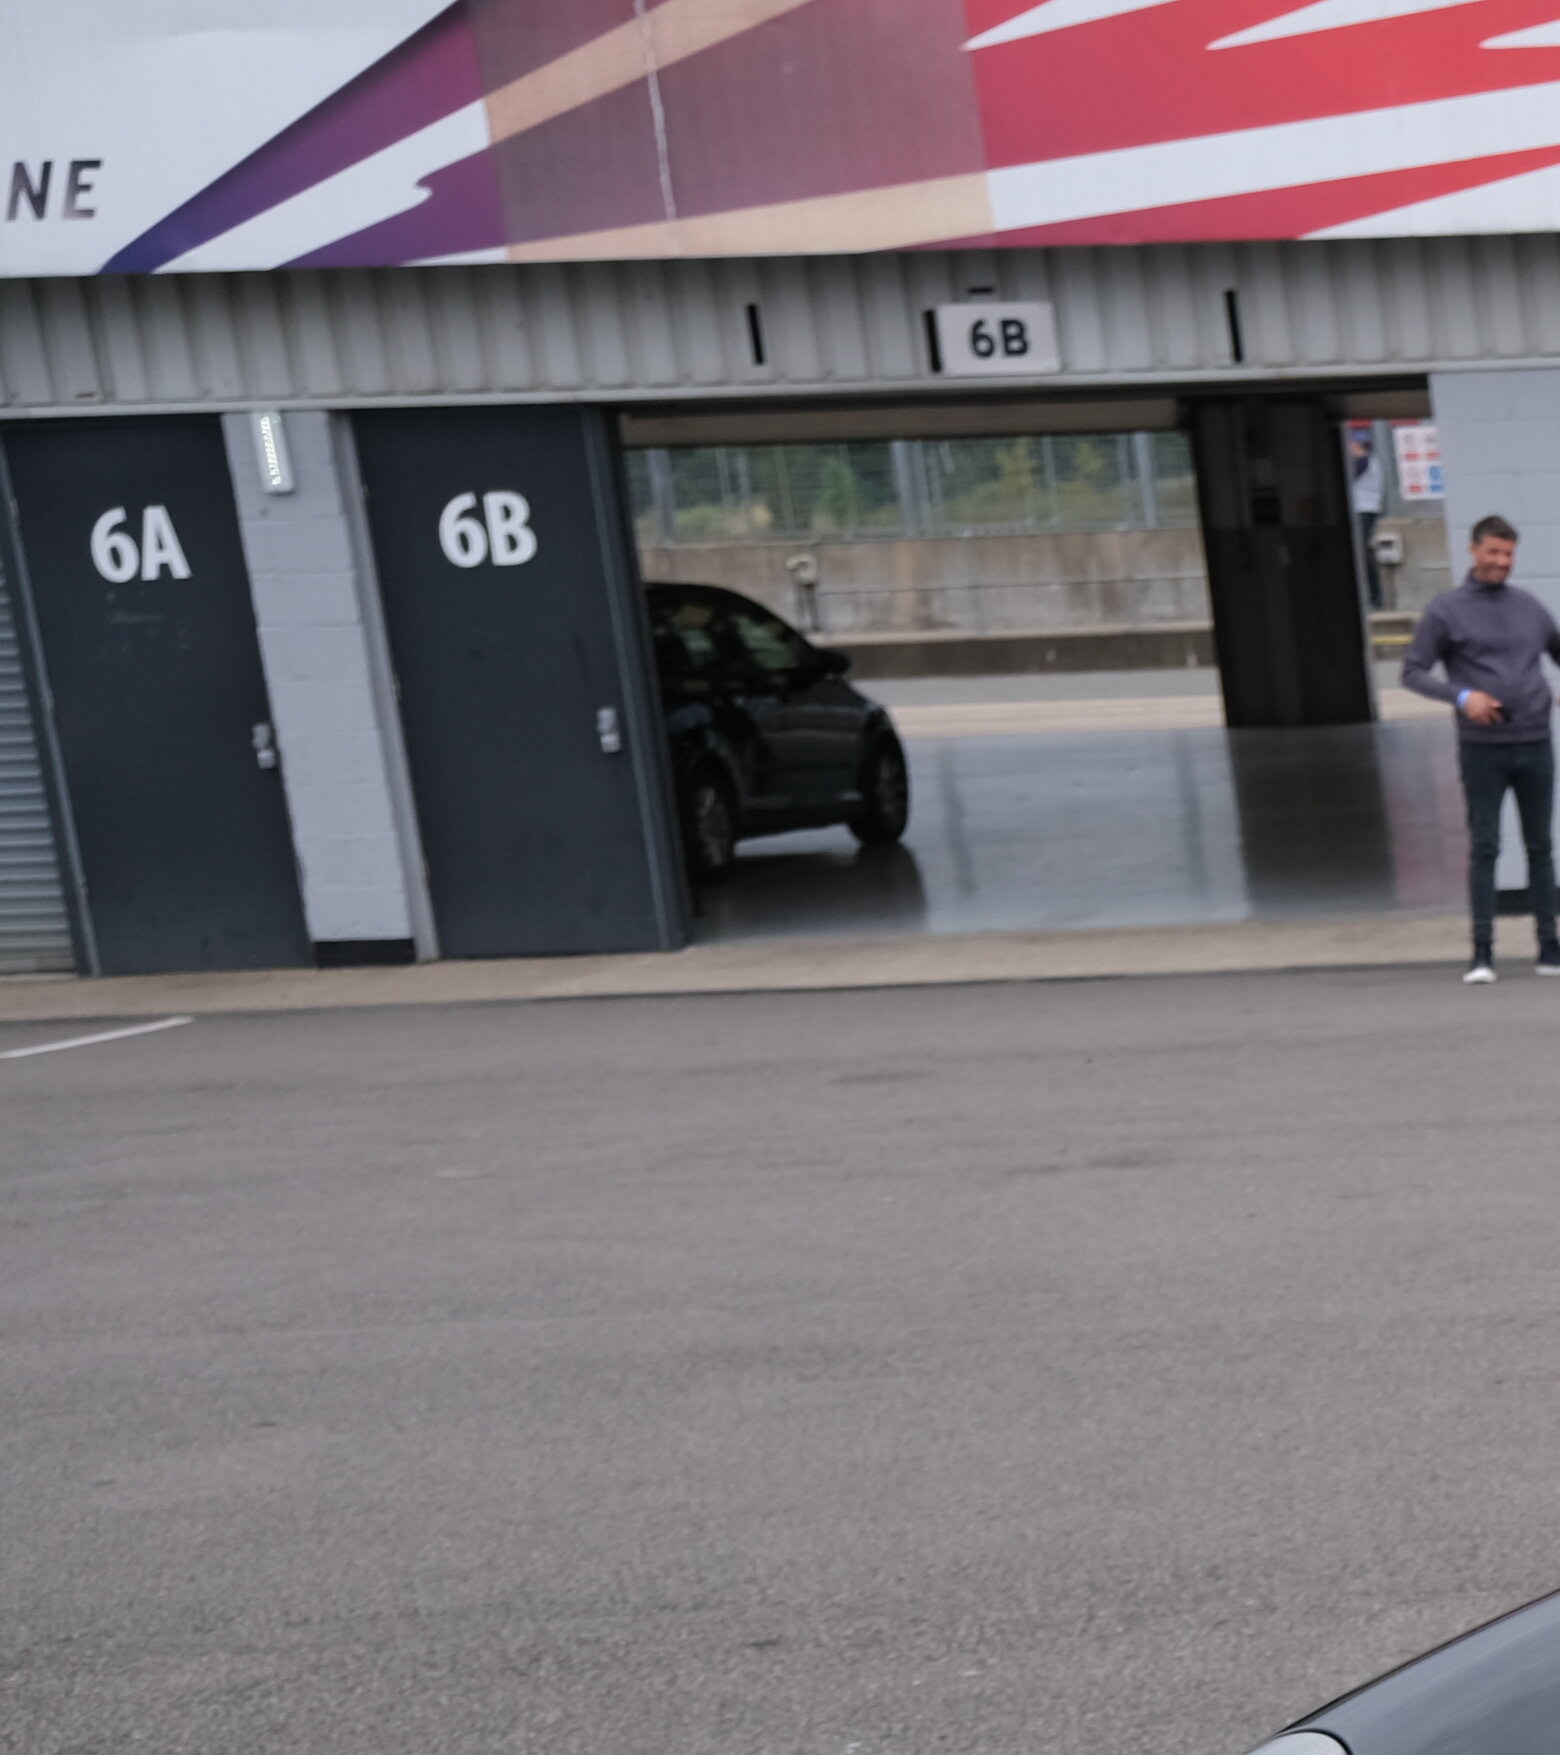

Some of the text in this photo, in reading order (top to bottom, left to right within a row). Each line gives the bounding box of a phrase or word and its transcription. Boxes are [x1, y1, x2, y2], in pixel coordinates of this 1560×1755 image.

[4, 158, 104, 222] NE
[971, 318, 1029, 359] 6B
[90, 503, 193, 584] 6A
[438, 489, 538, 569] 6B
